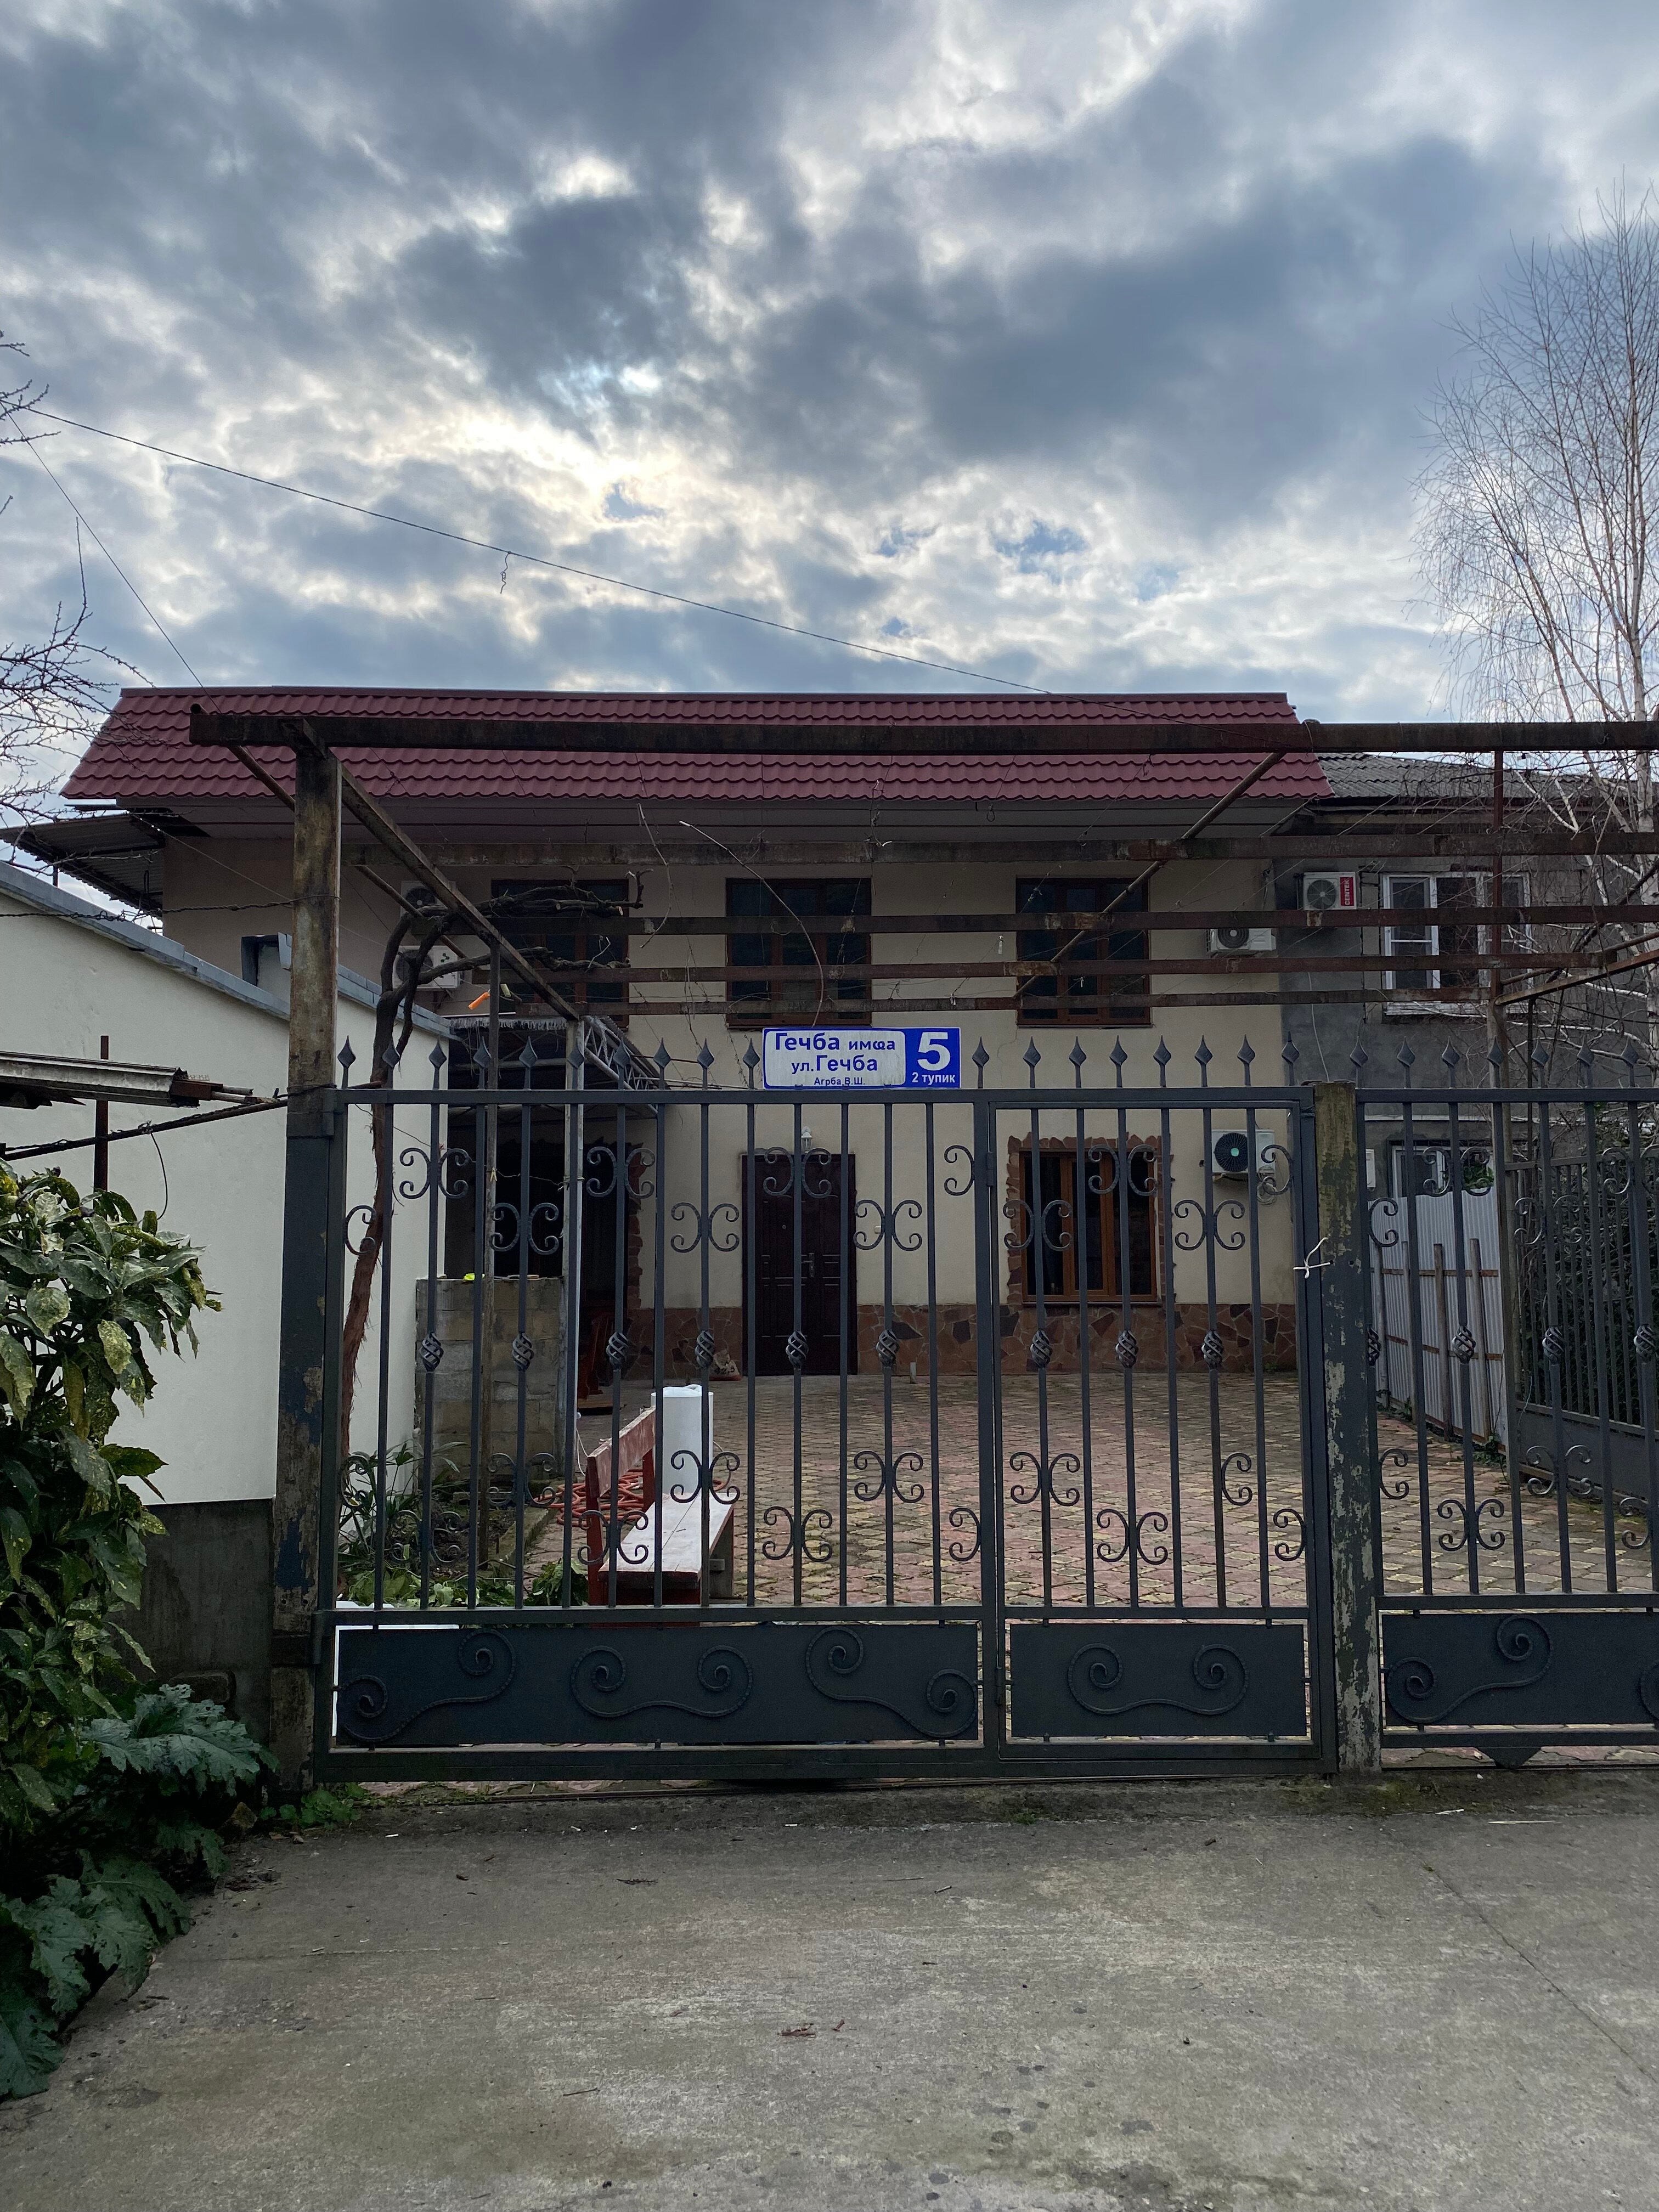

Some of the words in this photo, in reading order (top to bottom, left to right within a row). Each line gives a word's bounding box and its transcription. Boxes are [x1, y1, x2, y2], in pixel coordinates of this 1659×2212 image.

[775, 1032, 840, 1051] Гечба
[917, 1031, 951, 1071] 5
[814, 1077, 842, 1087] Агрба
[912, 1071, 919, 1083] 2
[921, 1074, 956, 1086] тупик
